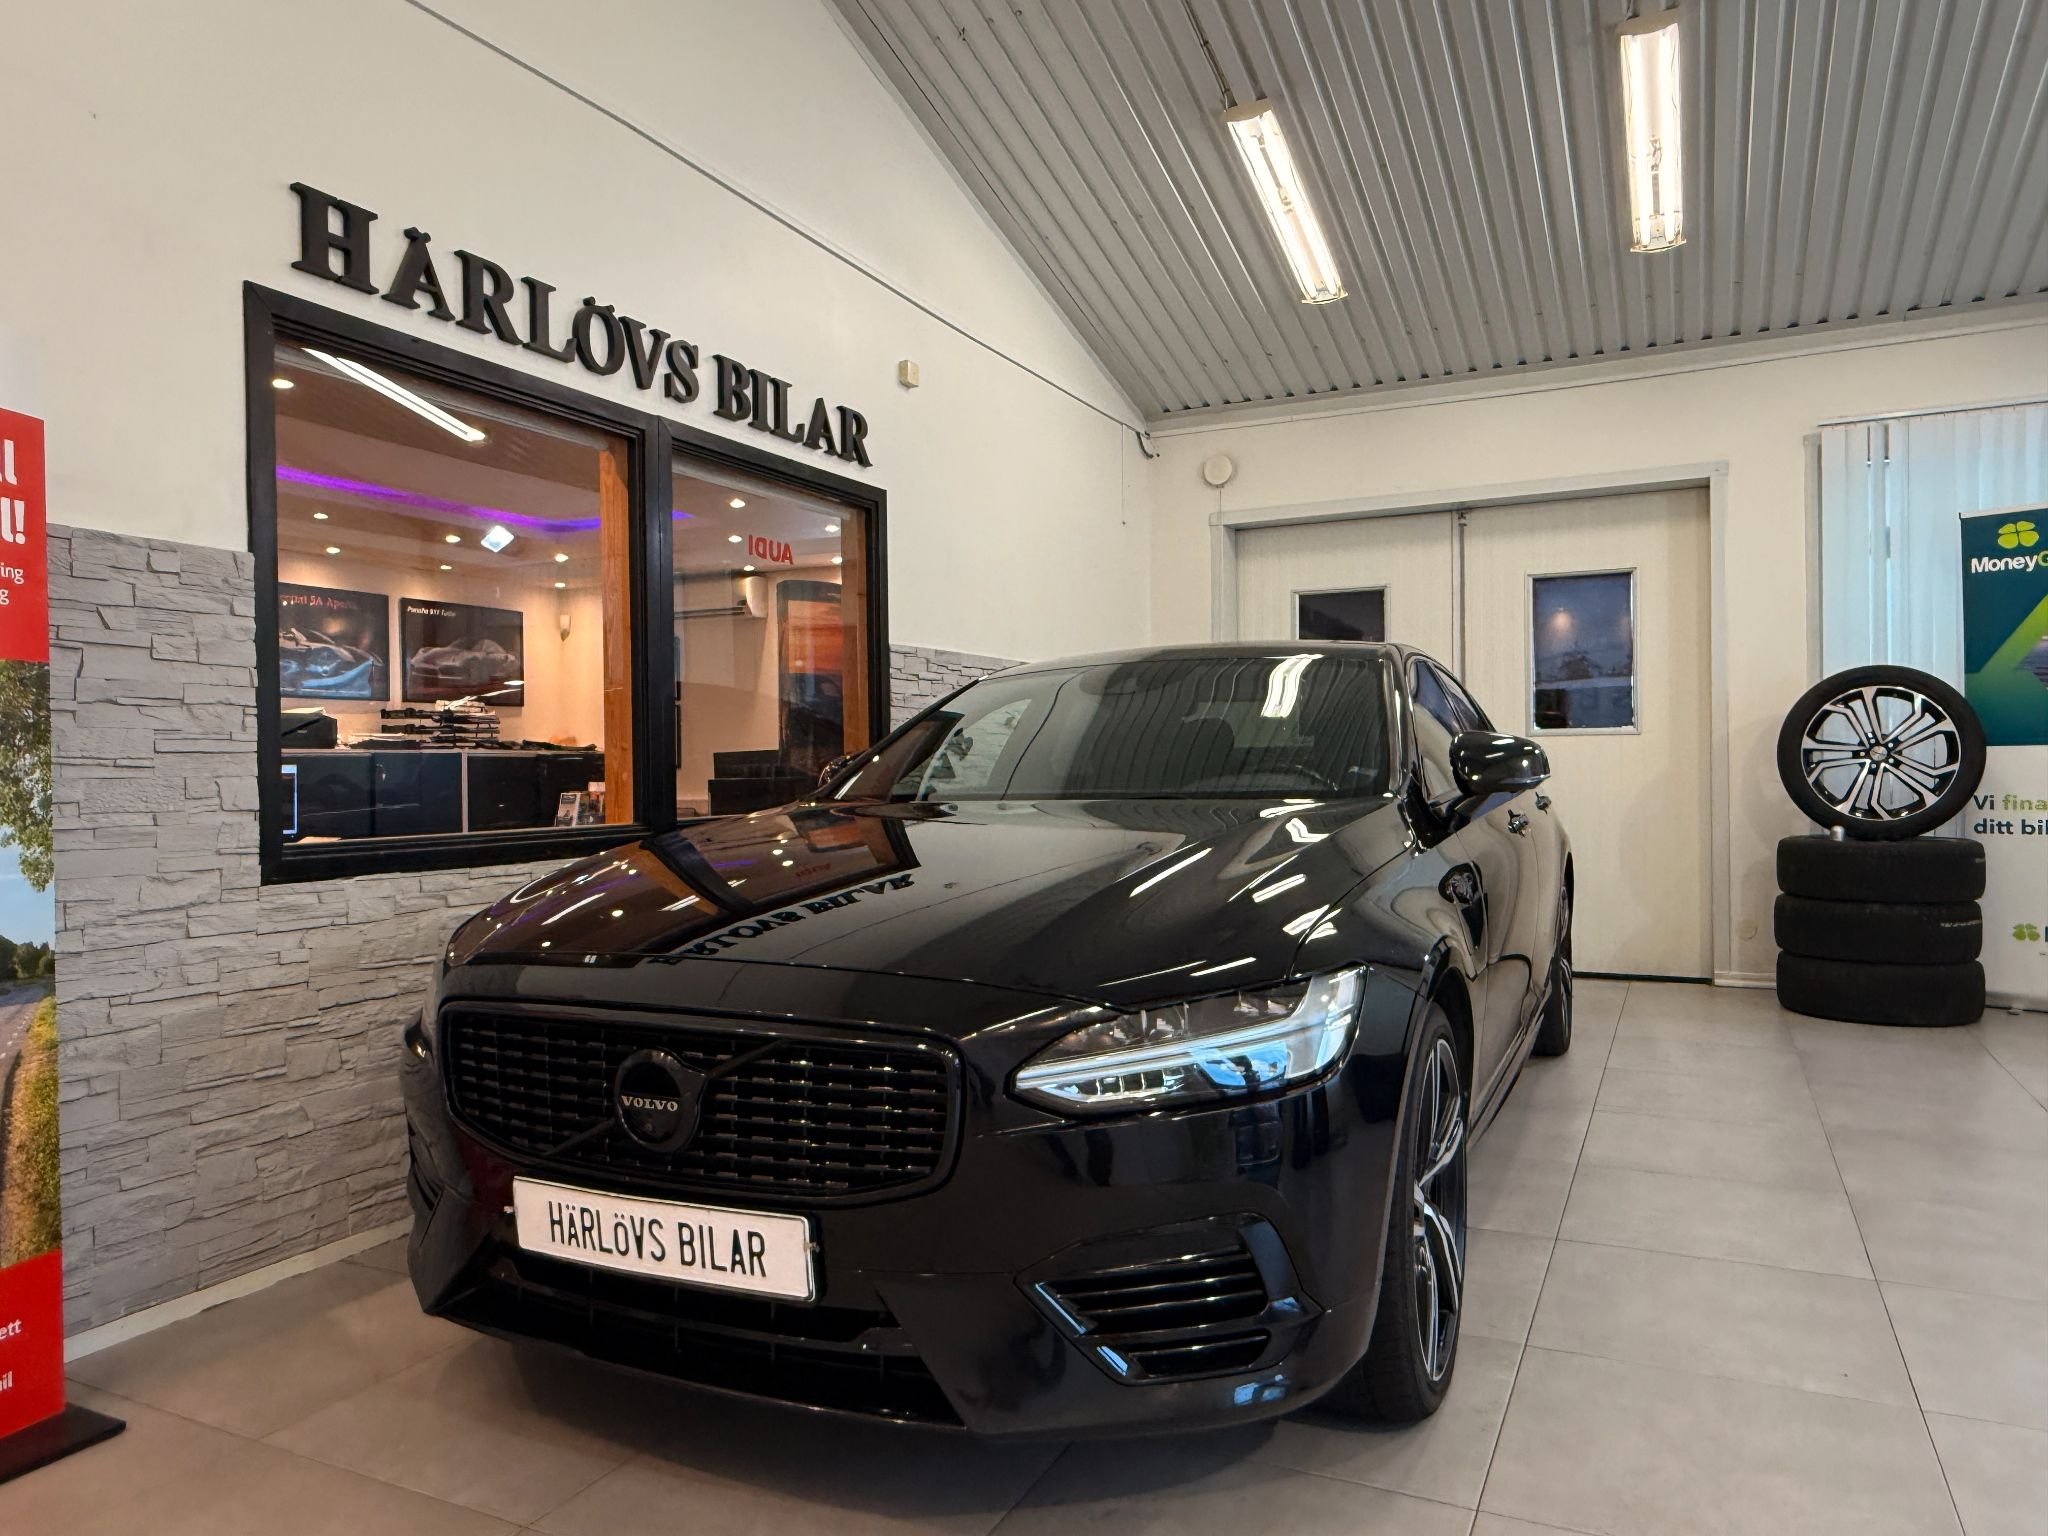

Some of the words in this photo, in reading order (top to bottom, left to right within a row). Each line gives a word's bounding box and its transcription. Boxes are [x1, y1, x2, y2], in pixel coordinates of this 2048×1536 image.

[290, 182, 699, 403] HÄRLÖVS
[712, 354, 873, 467] BILAR
[1973, 795, 1995, 810] Vi
[1973, 818, 2014, 835] ditt
[621, 1095, 678, 1111] VOLVO
[548, 1200, 666, 1262] HÄRLÖVS
[677, 1222, 767, 1278] BILAR
